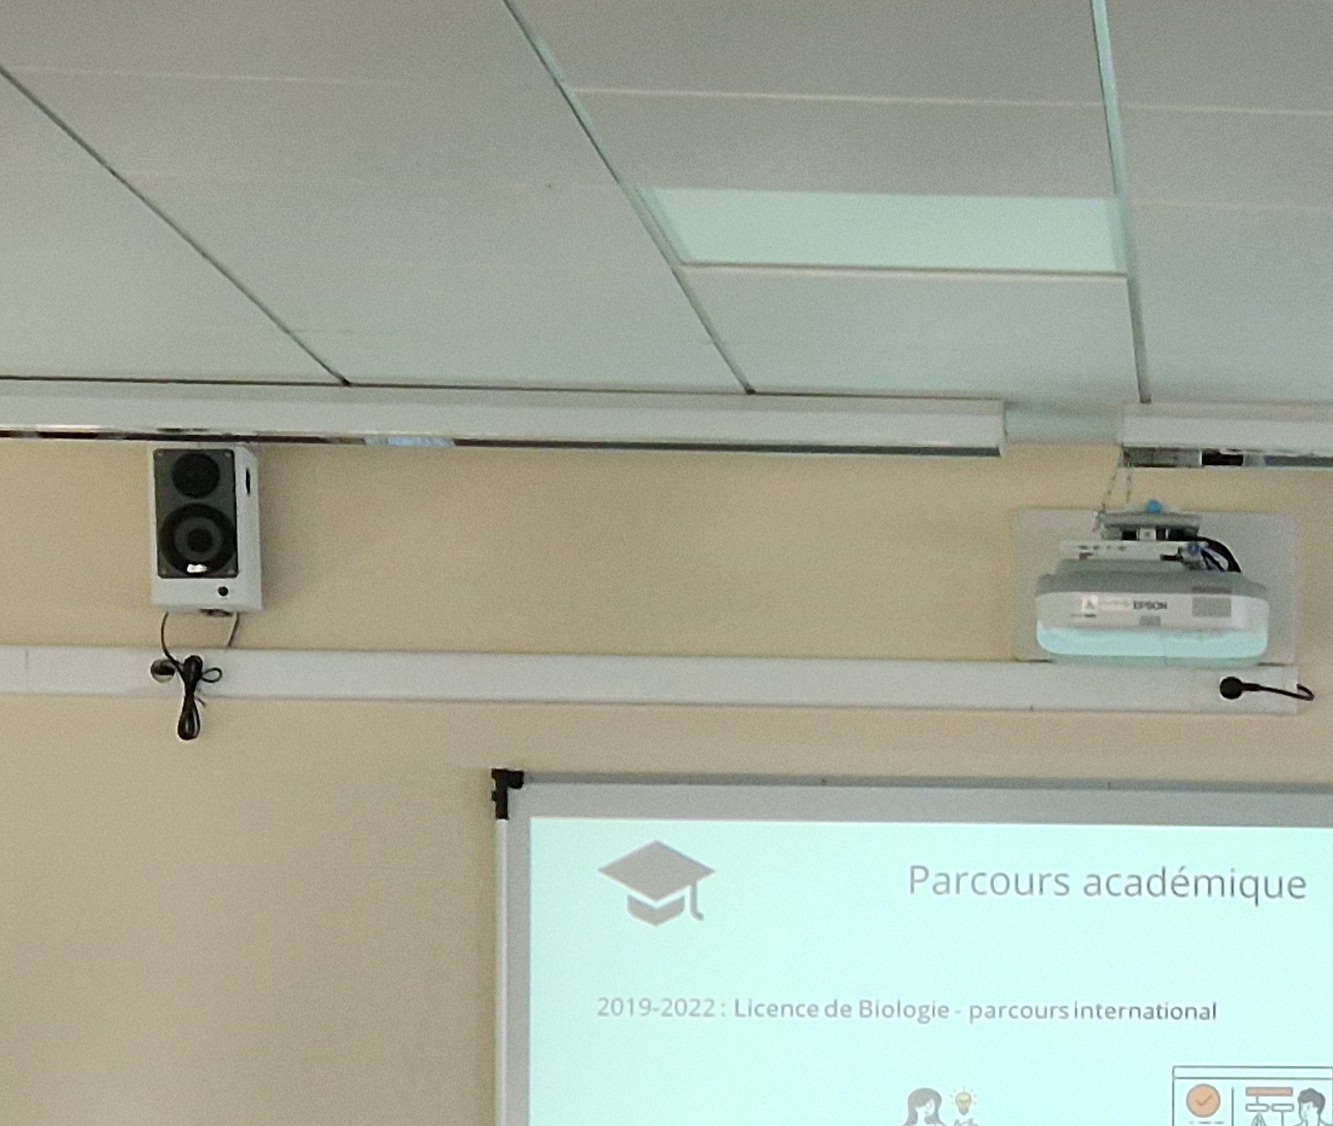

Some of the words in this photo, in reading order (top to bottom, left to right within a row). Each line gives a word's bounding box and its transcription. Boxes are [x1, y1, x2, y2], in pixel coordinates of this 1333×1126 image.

[909, 865, 1071, 896] Parcours
[1083, 865, 1307, 907] académique
[597, 997, 716, 1017] 2019-2022
[735, 999, 819, 1018] Licence
[824, 999, 852, 1018] de
[859, 1000, 950, 1024] Biologie
[969, 1003, 1070, 1024] parcours
[1074, 1001, 1217, 1020] international
